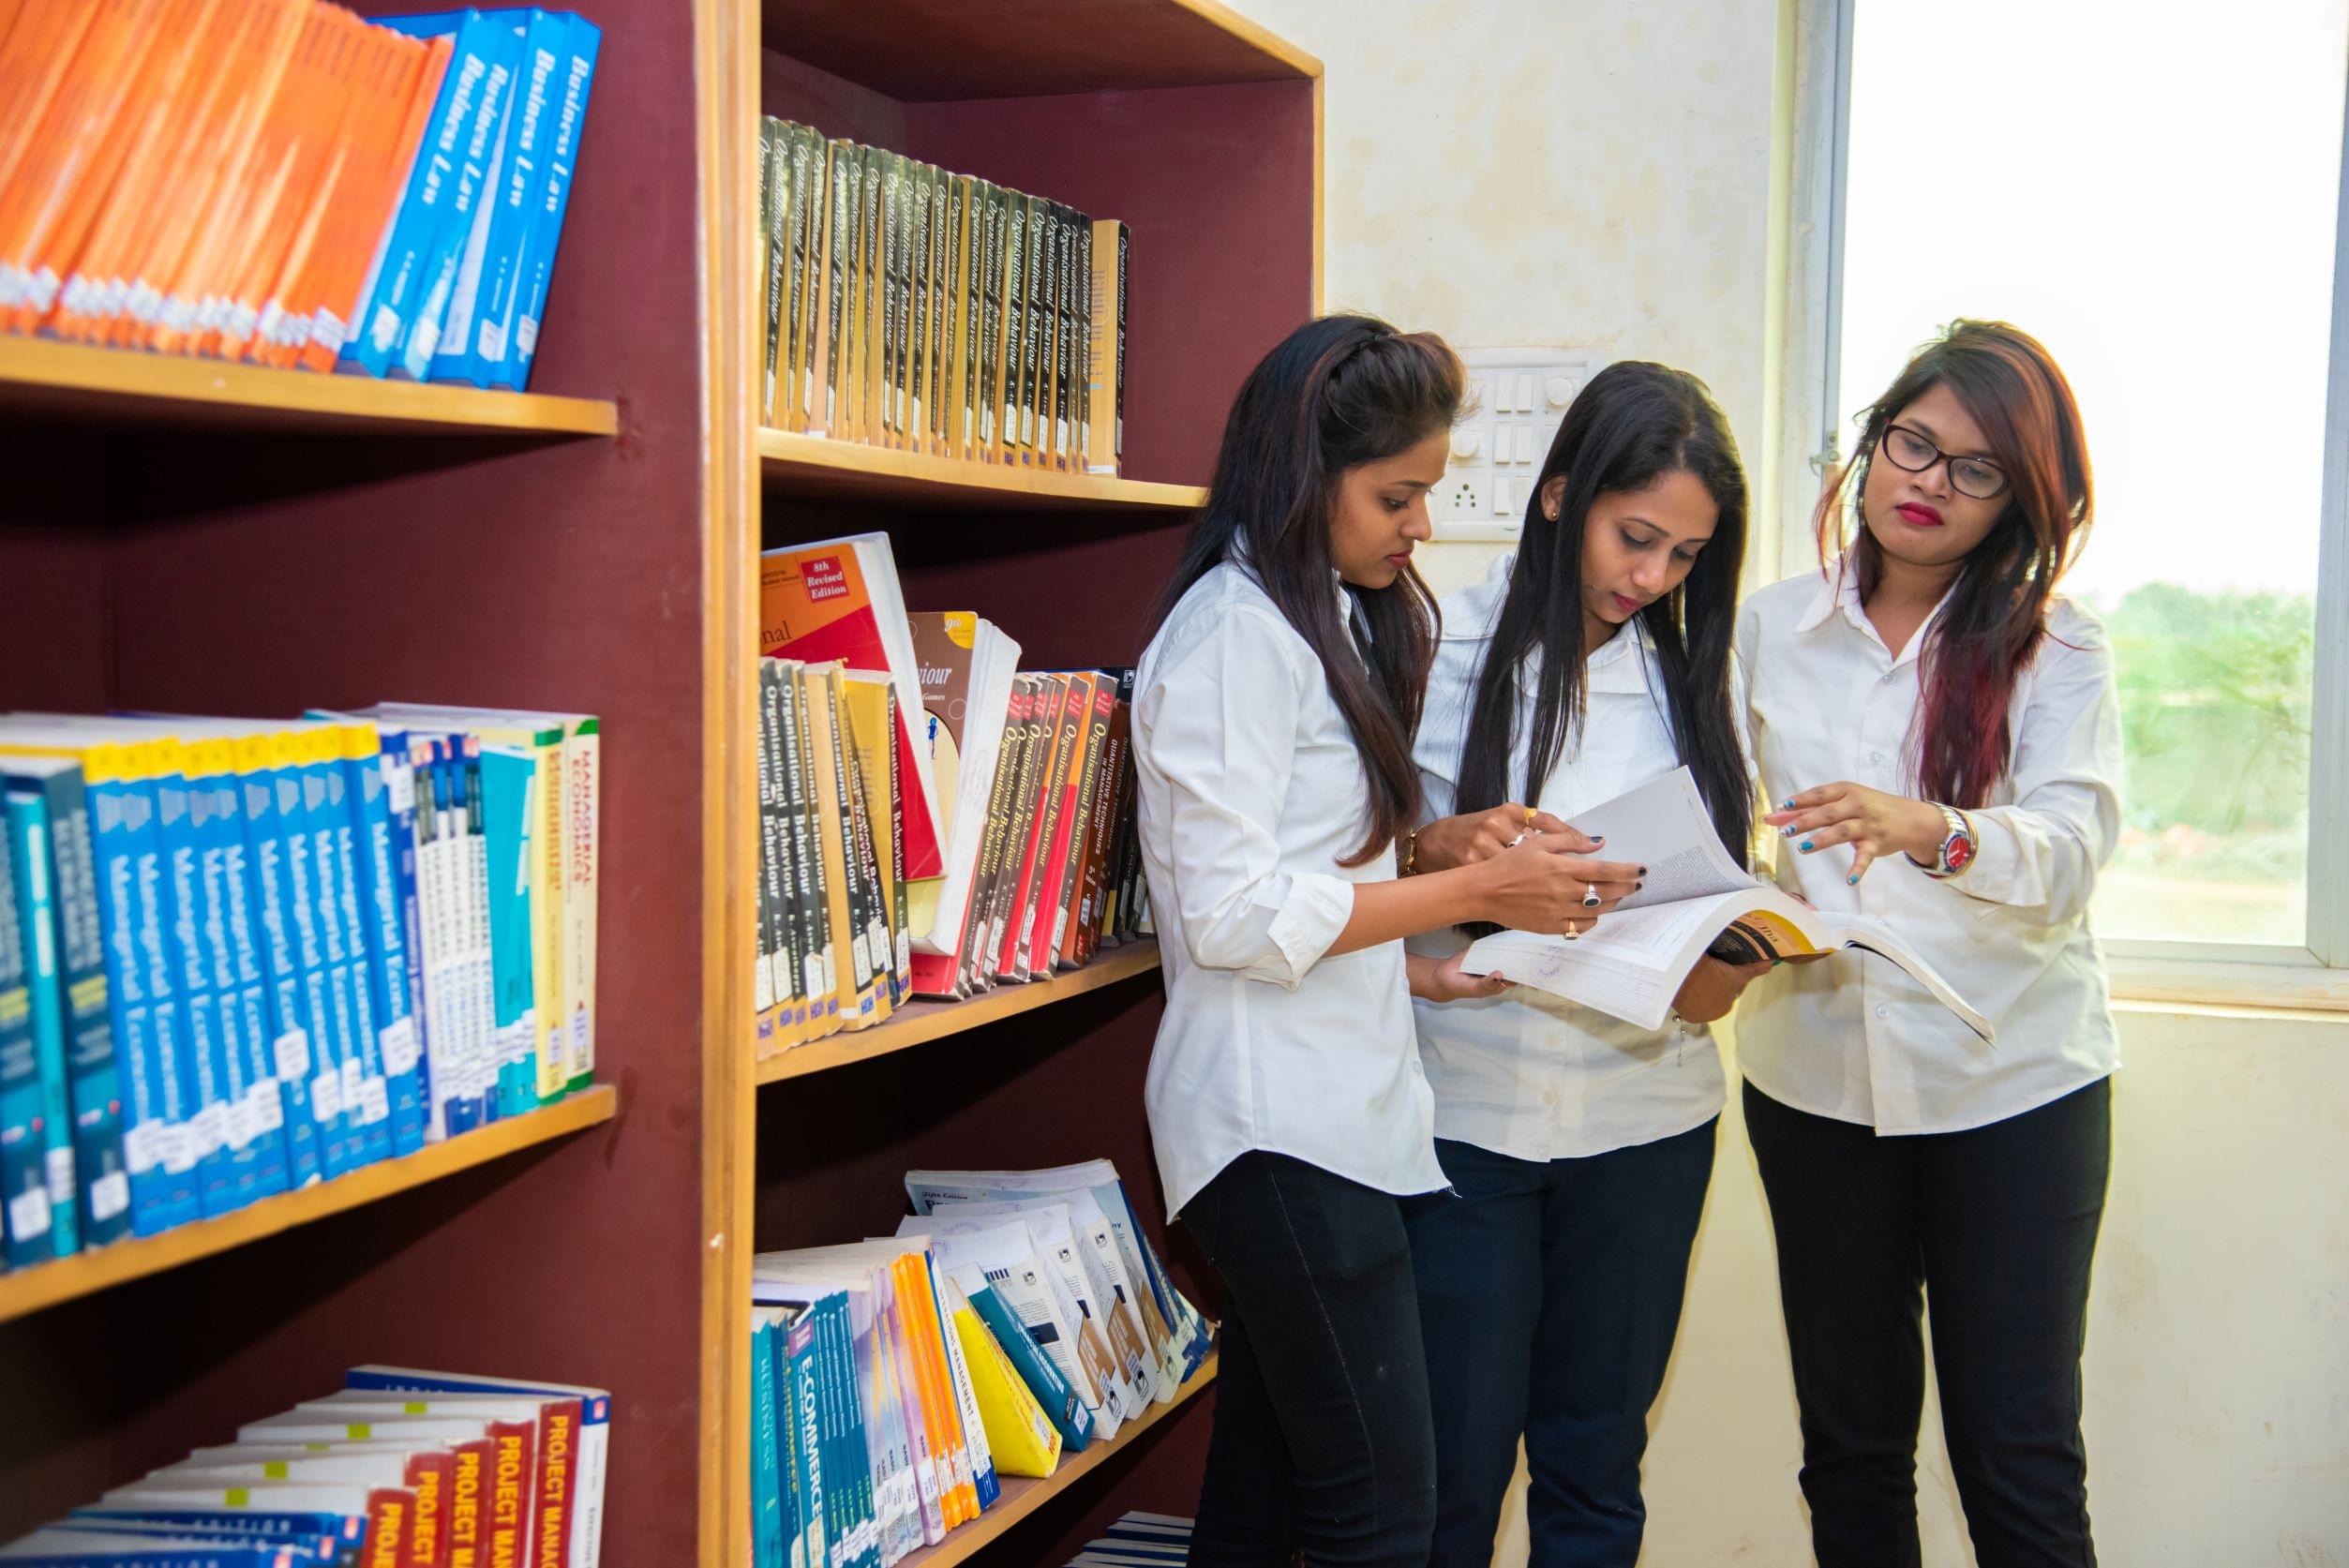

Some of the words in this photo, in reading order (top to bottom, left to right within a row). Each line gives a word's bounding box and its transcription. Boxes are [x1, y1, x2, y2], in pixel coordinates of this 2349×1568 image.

[440, 53, 486, 151] Business
[469, 64, 508, 158] Business
[520, 48, 555, 150] Business
[557, 55, 590, 156] Business
[422, 154, 451, 205] Law
[456, 162, 481, 211] Law
[510, 156, 533, 206] Law
[546, 162, 568, 211] Law
[885, 173, 899, 277] Organisational
[901, 181, 913, 283] Organisational
[917, 183, 931, 284] Organisational
[934, 185, 947, 286] Organisational
[969, 197, 982, 295] Organisational
[984, 200, 997, 297] Organisational
[1010, 209, 1026, 306] Organisational
[1030, 212, 1045, 308] Organisational
[1045, 216, 1059, 309] Organisational
[1058, 223, 1071, 317] Organisational
[1081, 231, 1092, 321] Organisational
[1009, 306, 1023, 369] Behaviour
[1028, 306, 1040, 372] Behaviour
[1042, 309, 1055, 374] Behaviour
[1056, 317, 1070, 381] Behaviour
[1079, 321, 1091, 383] Behaviour
[807, 571, 844, 587] Revised
[811, 585, 847, 600] Edition
[814, 560, 830, 573] 8th
[766, 685, 788, 808] Organisational
[778, 816, 794, 898] Behaviour
[782, 684, 806, 805] Organisational
[794, 814, 811, 895] Behaviour
[992, 725, 1018, 815] Organisational
[1016, 724, 1041, 813] Organisational
[1049, 724, 1077, 808] Organisational
[1081, 723, 1106, 808] Organisational
[1094, 768, 1107, 830] MANAGEMENT
[1103, 739, 1118, 799] QUANTITATIVE
[572, 759, 582, 882] ECONOMICS
[581, 751, 591, 886] MANAGERIAL
[763, 814, 780, 899] Behaviour
[843, 816, 859, 894] Behaviour
[892, 811, 903, 883] Behaviour
[980, 815, 997, 878] Behaviour
[991, 813, 1010, 875] Behaviour
[1006, 813, 1023, 871] Behaviour
[1040, 807, 1058, 867] Behaviour
[1070, 808, 1088, 866] Behaviour
[1095, 800, 1110, 855] TECHNIQUES
[939, 1288, 955, 1349] OPERATIONS
[953, 1349, 974, 1416] MANAGEMENT
[495, 1436, 522, 1526] PROJECT
[545, 1414, 570, 1503] PROJECT
[801, 1355, 823, 1518] E-COMMERCE
[412, 1471, 441, 1564] PROJECT
[452, 1452, 481, 1545] PROJECT
